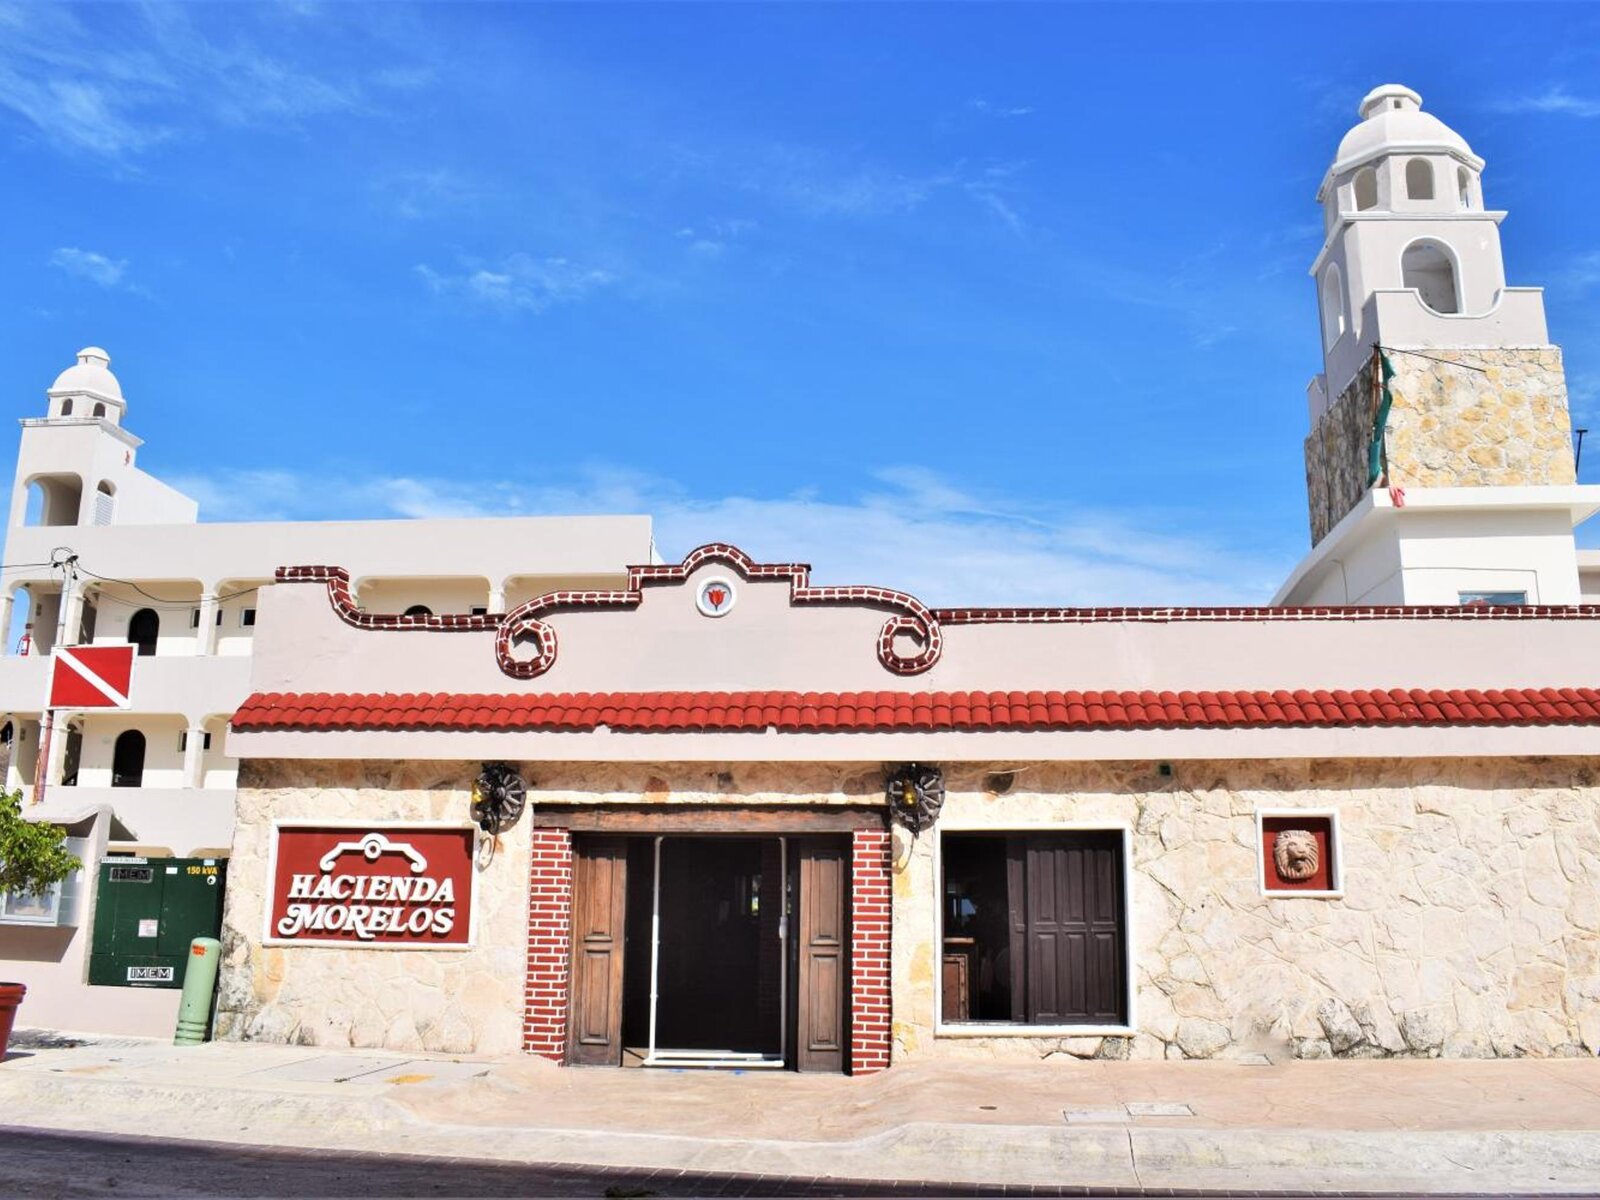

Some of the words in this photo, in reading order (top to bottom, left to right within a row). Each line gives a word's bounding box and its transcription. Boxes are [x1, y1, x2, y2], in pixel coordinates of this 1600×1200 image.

[112, 869, 150, 880] IMEM
[186, 866, 201, 875] 150
[202, 866, 218, 876] kVA
[287, 874, 455, 902] HACIENDA
[278, 903, 455, 939] MORELOS
[131, 968, 171, 979] IMEM
